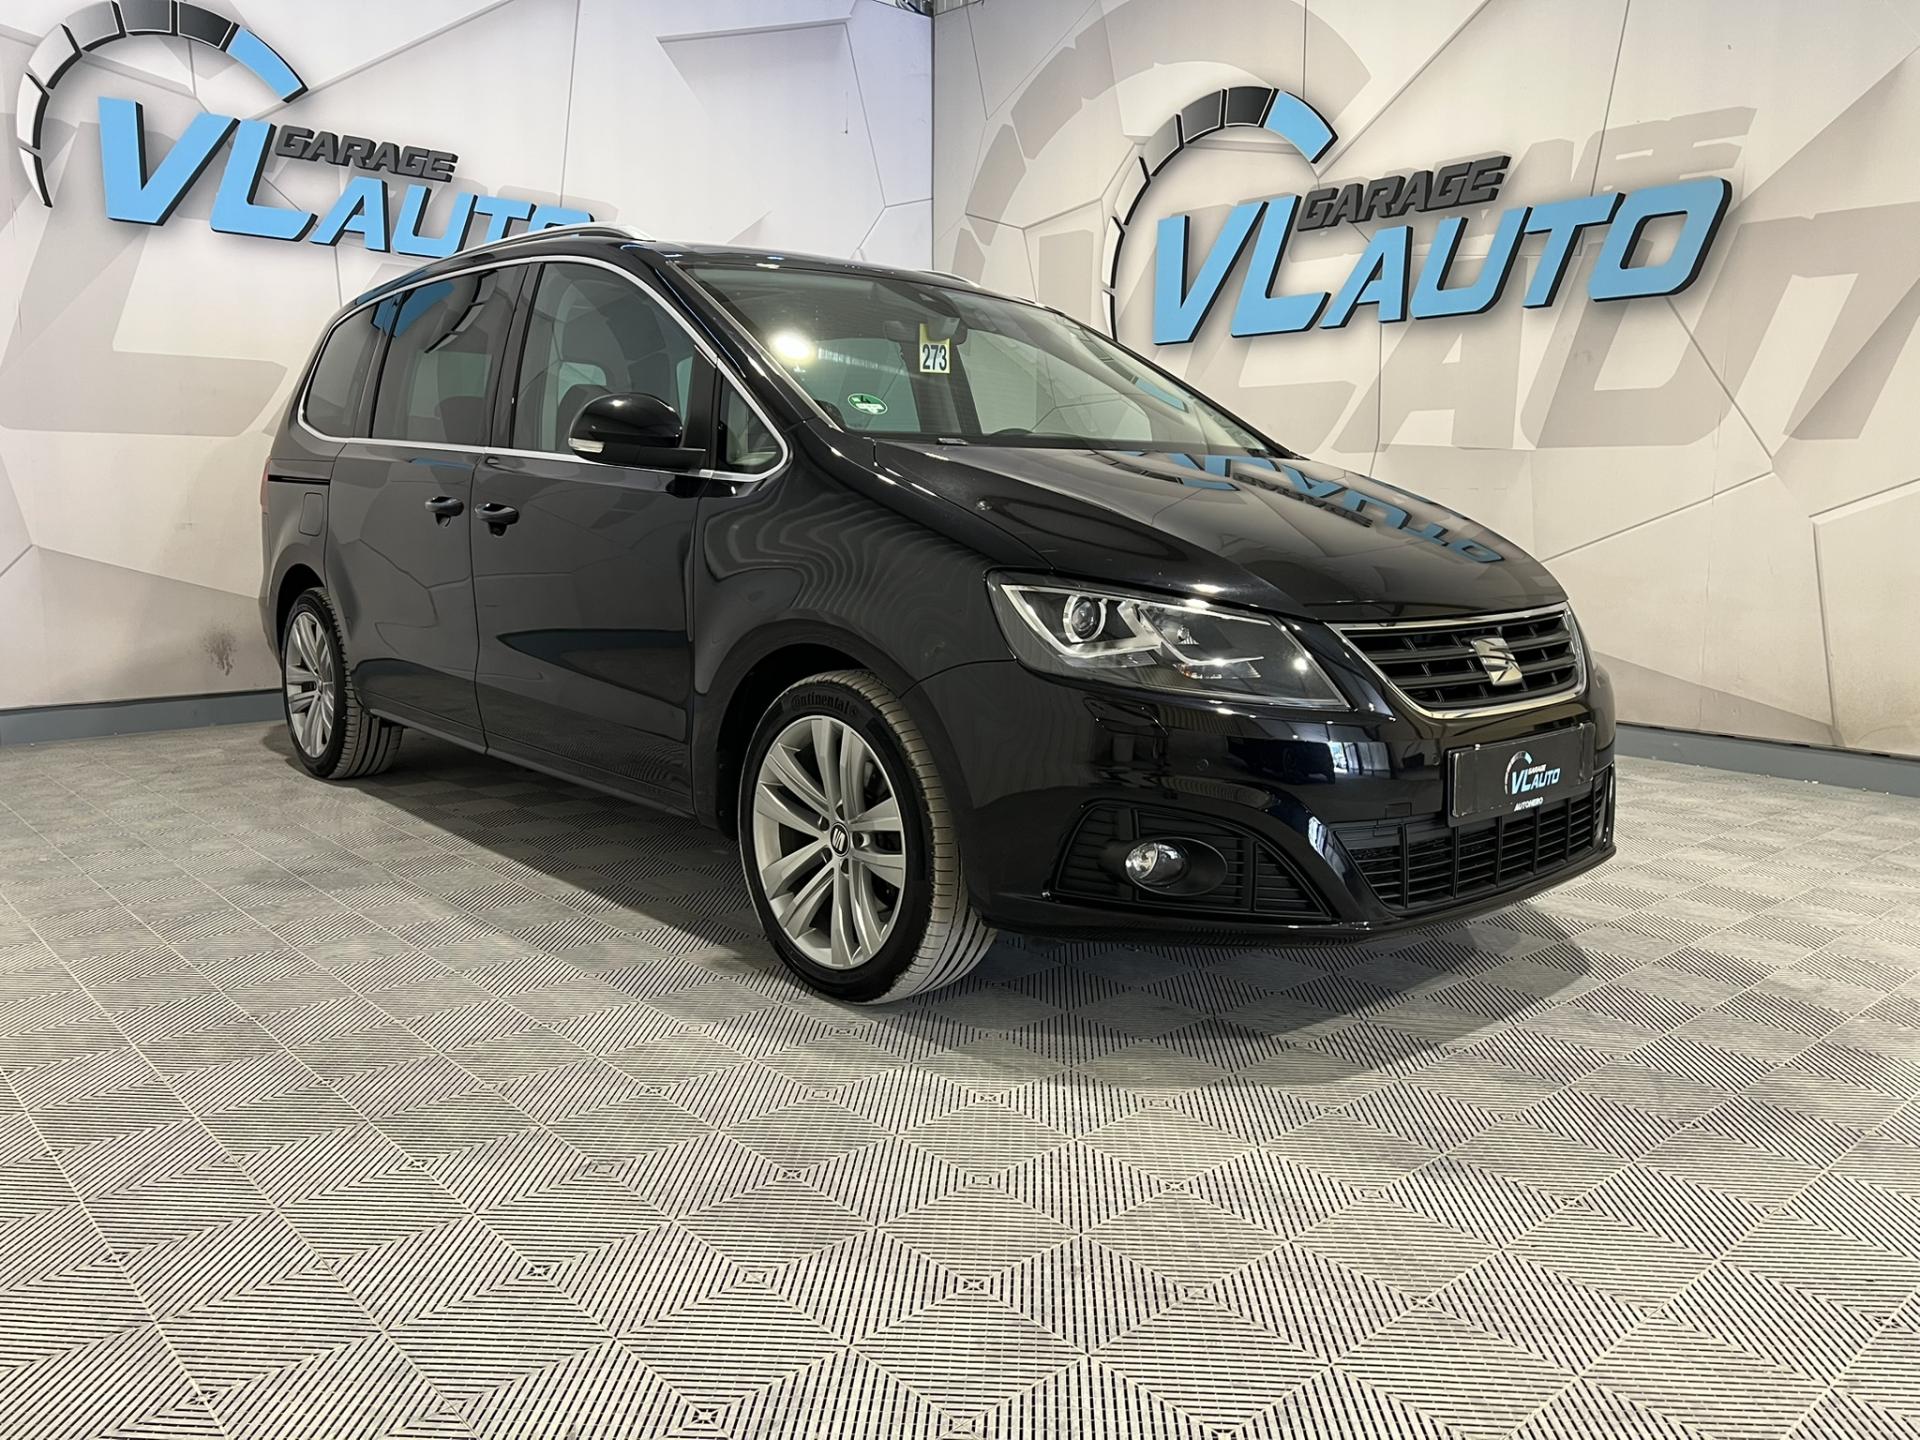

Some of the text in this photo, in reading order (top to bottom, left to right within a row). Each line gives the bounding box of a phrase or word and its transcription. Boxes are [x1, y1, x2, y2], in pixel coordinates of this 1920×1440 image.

[275, 125, 458, 182] GARAGE
[1297, 155, 1511, 231] GARAGE
[922, 343, 948, 371] 273
